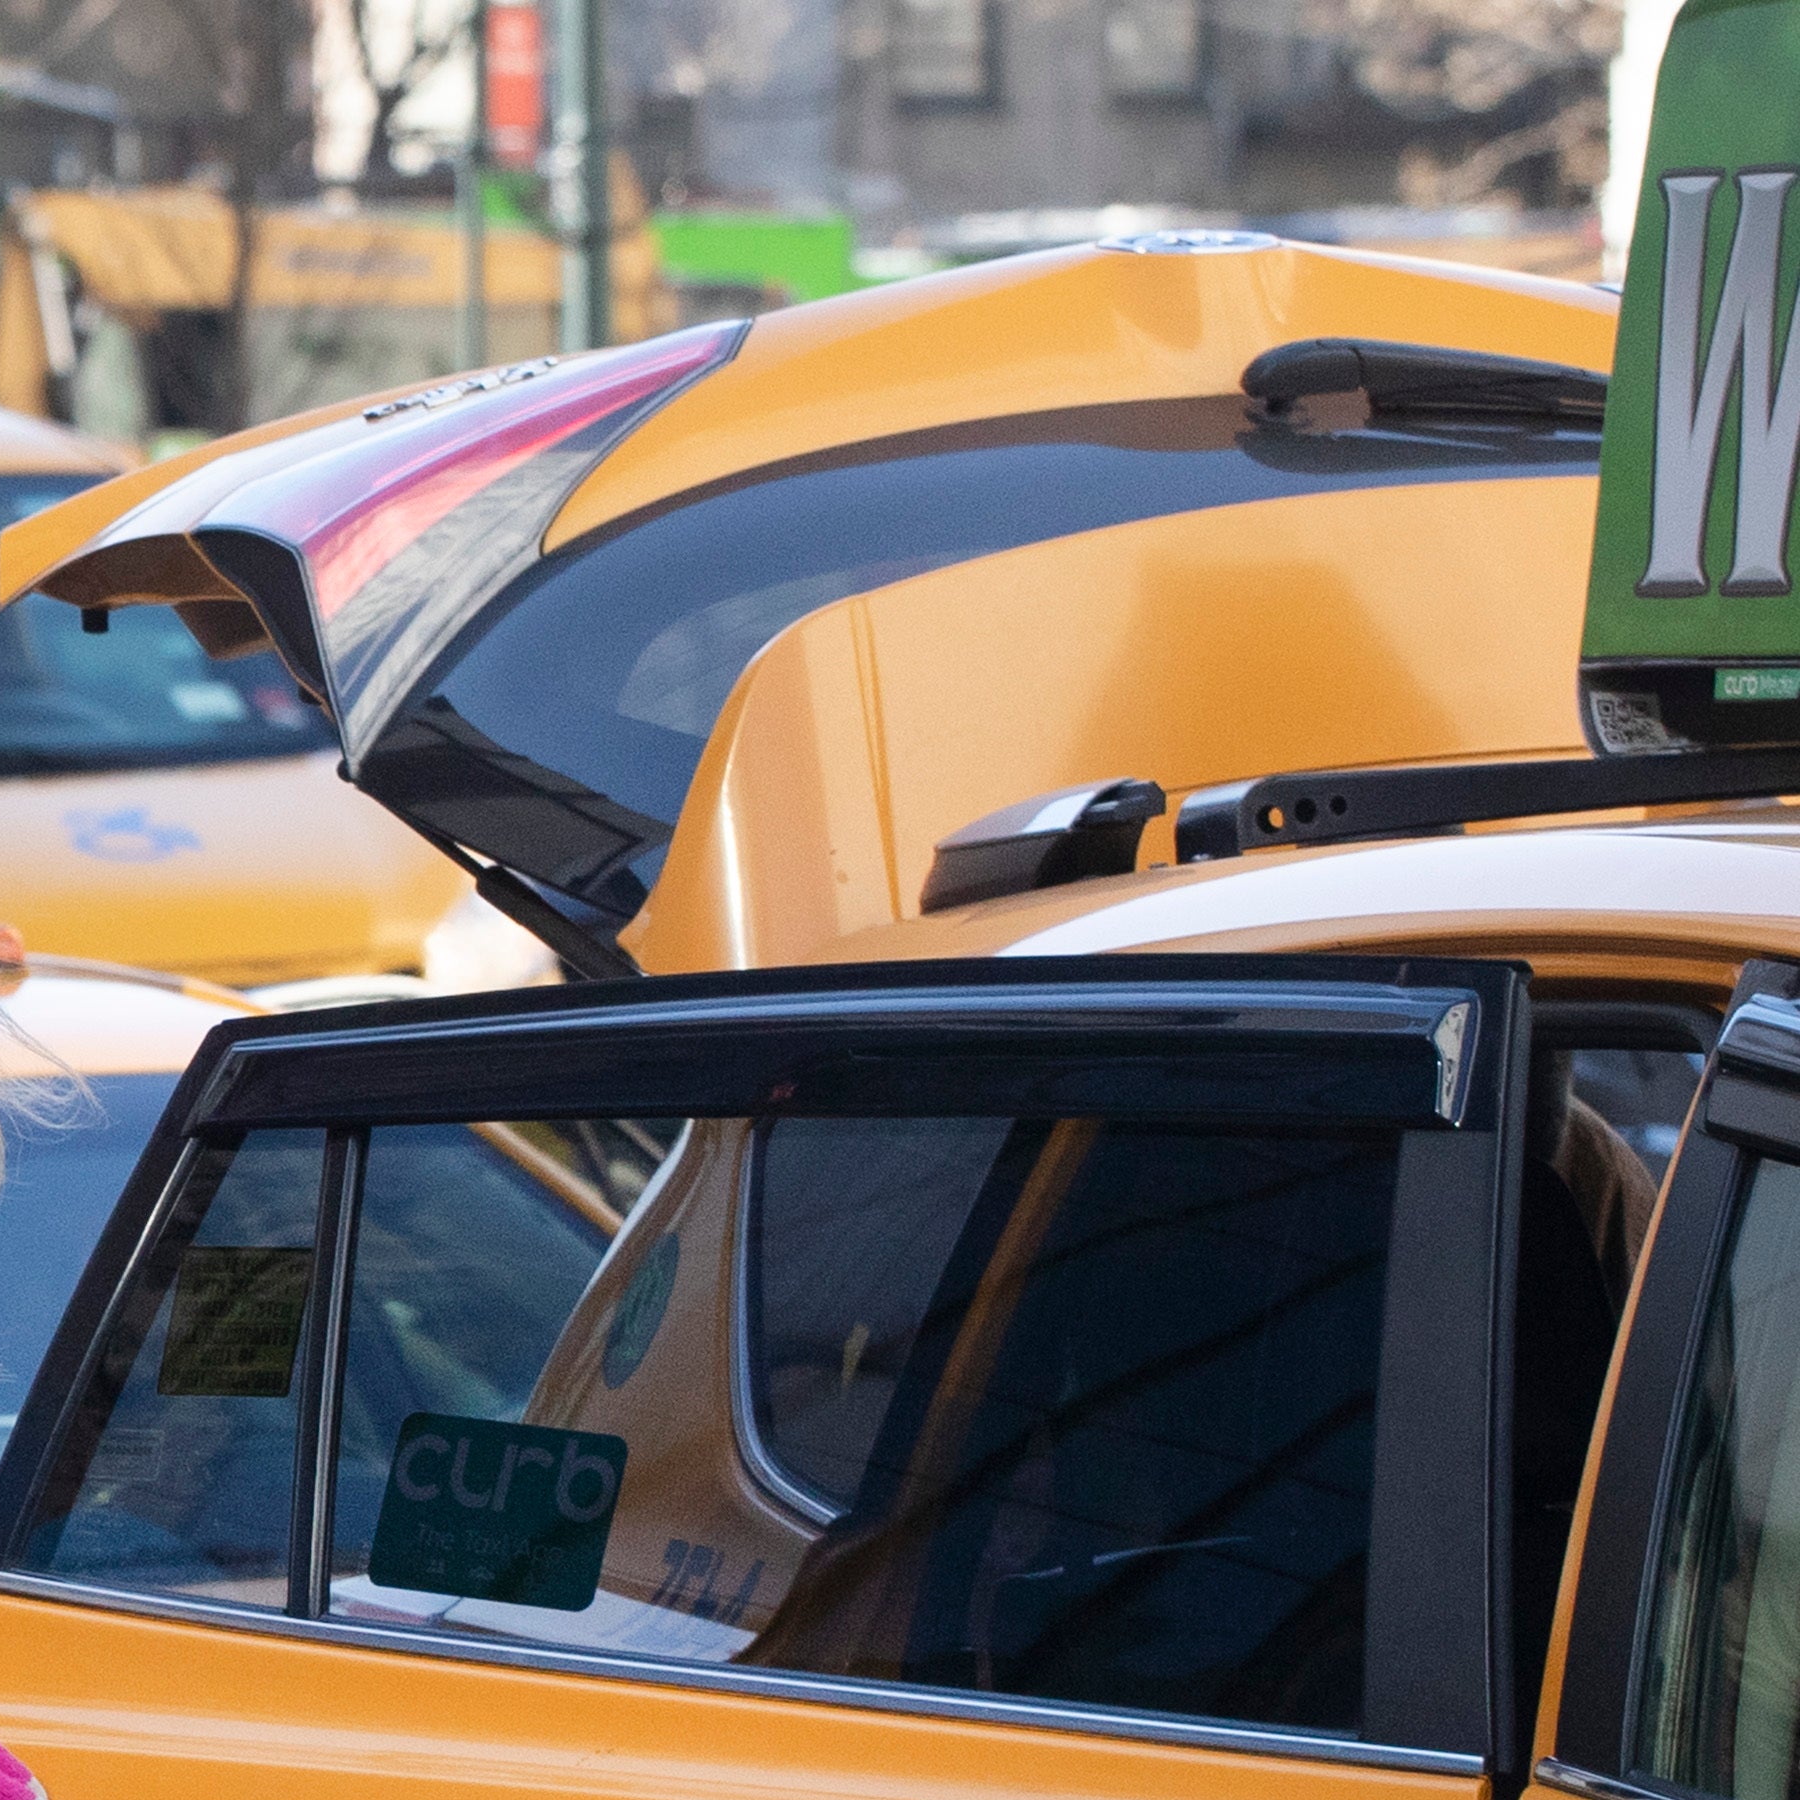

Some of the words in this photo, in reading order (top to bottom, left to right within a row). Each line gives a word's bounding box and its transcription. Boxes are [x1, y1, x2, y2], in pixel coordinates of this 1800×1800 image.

[395, 1432, 617, 1524] curb
[418, 1520, 455, 1552] The
[465, 1528, 509, 1557] Taxi
